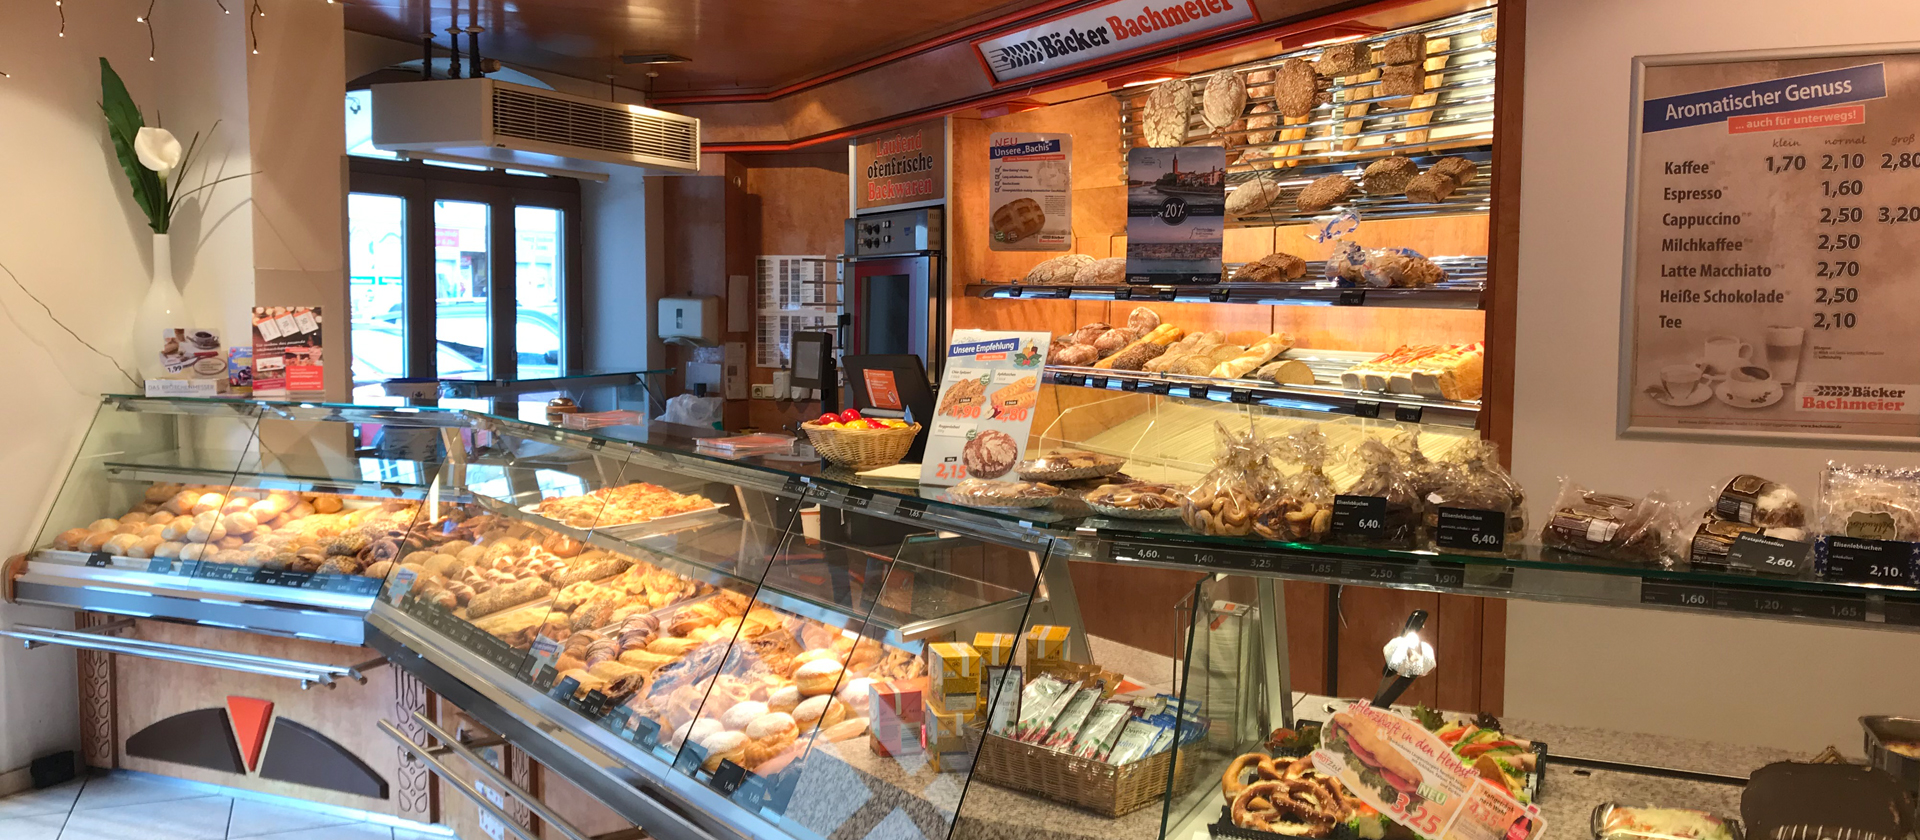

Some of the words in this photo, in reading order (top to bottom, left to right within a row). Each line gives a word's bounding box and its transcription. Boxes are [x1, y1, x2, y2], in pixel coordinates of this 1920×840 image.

[1038, 24, 1110, 58] Bäcker
[1106, 0, 1234, 40] Bachmeier
[1665, 88, 1782, 121] Aromatischer
[1785, 78, 1852, 101] Genuss
[1746, 118, 1773, 128] auch
[1775, 116, 1792, 126] für
[1794, 110, 1856, 126] unterwegs!
[876, 130, 922, 157] Laufend
[995, 138, 1018, 146] NEU
[1772, 138, 1801, 148] klein
[1824, 136, 1867, 146] normal
[1892, 134, 1915, 146] groß
[994, 146, 1021, 156] Unsere
[868, 152, 933, 180] ofenfrische
[1664, 161, 1709, 174] Kaffee
[1765, 155, 1806, 174] 1,70
[1821, 154, 1865, 172] 2,10
[868, 177, 932, 202] Backwaren
[1664, 188, 1722, 203] Espresso
[1822, 180, 1864, 198] 1,60
[1662, 212, 1741, 230] Cappuccino
[1820, 207, 1863, 226] 2,50
[1878, 206, 1920, 224] 3,20
[1662, 238, 1743, 252] Milchkaffee
[1817, 234, 1861, 252] 2,50
[1661, 264, 1697, 278] Latte
[1700, 264, 1772, 278] Macchiato
[1816, 261, 1860, 280] 2,70
[1660, 290, 1700, 304] Heiße
[1704, 289, 1784, 304] Schokolade
[1815, 288, 1859, 306] 2,50
[1659, 315, 1682, 328] Tee
[1814, 313, 1856, 331] 2,10
[954, 345, 975, 354] Unsere
[976, 341, 1014, 353] Empfehlung
[1852, 386, 1906, 398] Bäcker
[1802, 396, 1904, 411] Bachmeier
[952, 405, 981, 419] 1,90
[996, 408, 1028, 422] 2,80
[936, 463, 967, 479] 2,15
[1336, 500, 1368, 509] Elisenlebkuchen
[1442, 512, 1482, 521] Elisenlebkuchen
[1834, 542, 1882, 551] Elisenlebkuchen
[1401, 728, 1412, 744] in
[1415, 739, 1435, 757] den
[1418, 784, 1446, 804] NEU
[1391, 793, 1442, 834] 3,25
[1468, 802, 1500, 827] 4,35
[1480, 798, 1493, 809] nach
[1492, 804, 1507, 816] Wahl
